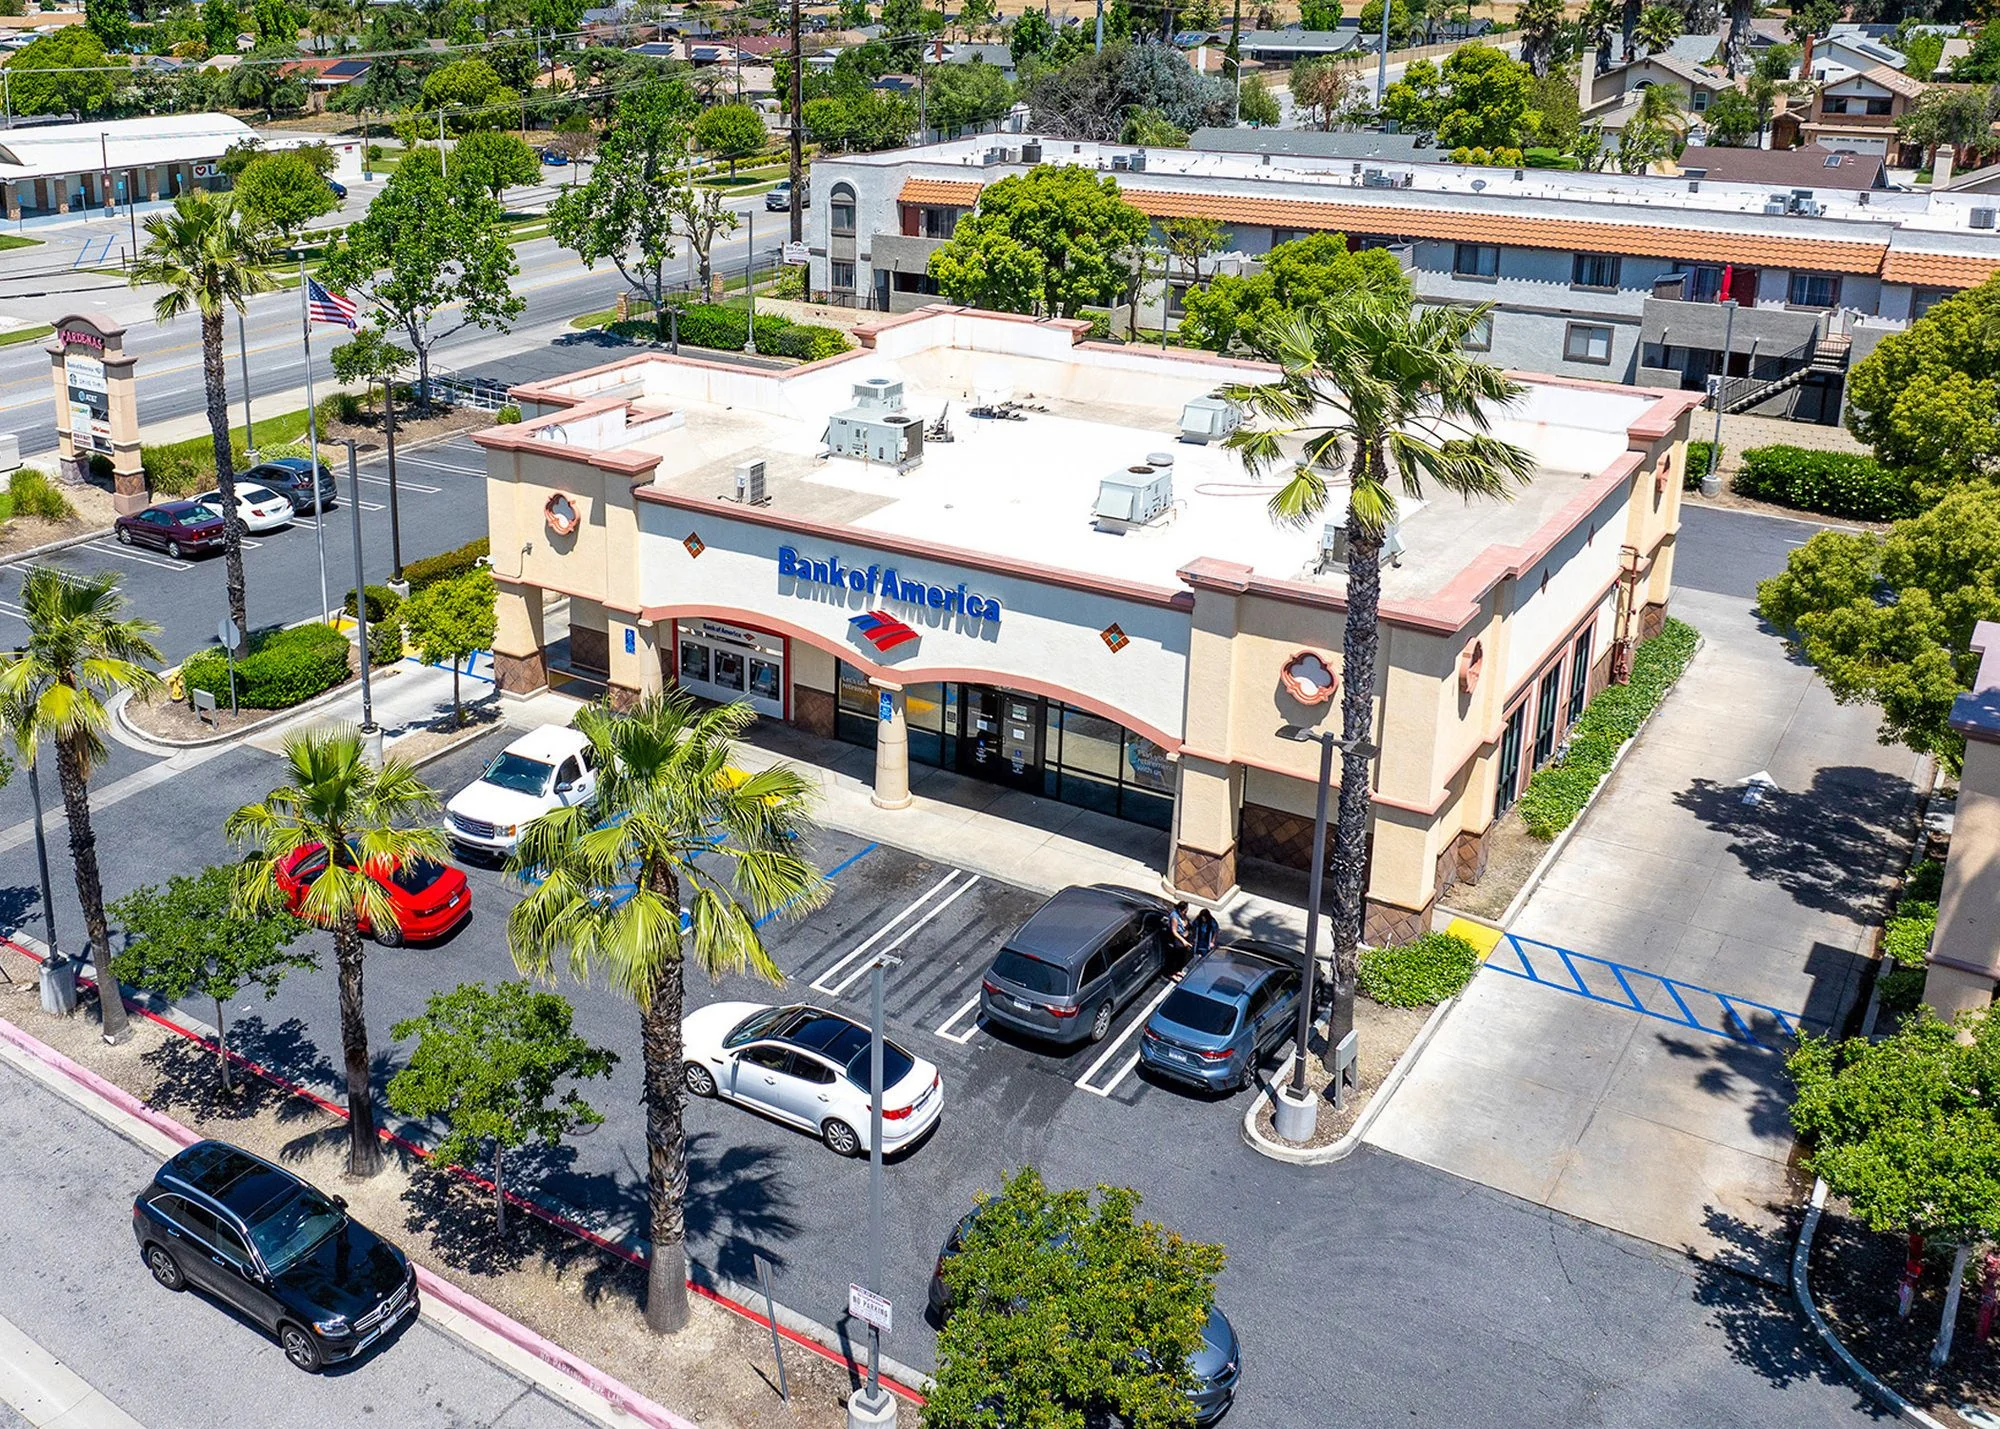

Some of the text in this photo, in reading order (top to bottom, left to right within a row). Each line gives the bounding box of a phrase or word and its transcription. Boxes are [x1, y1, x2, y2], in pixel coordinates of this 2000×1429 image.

[60, 330, 103, 350] CARDENAS
[778, 545, 1003, 623] Bank of America
[703, 623, 715, 631] Bank
[721, 627, 742, 638] America
[863, 1300, 888, 1318] PARKING
